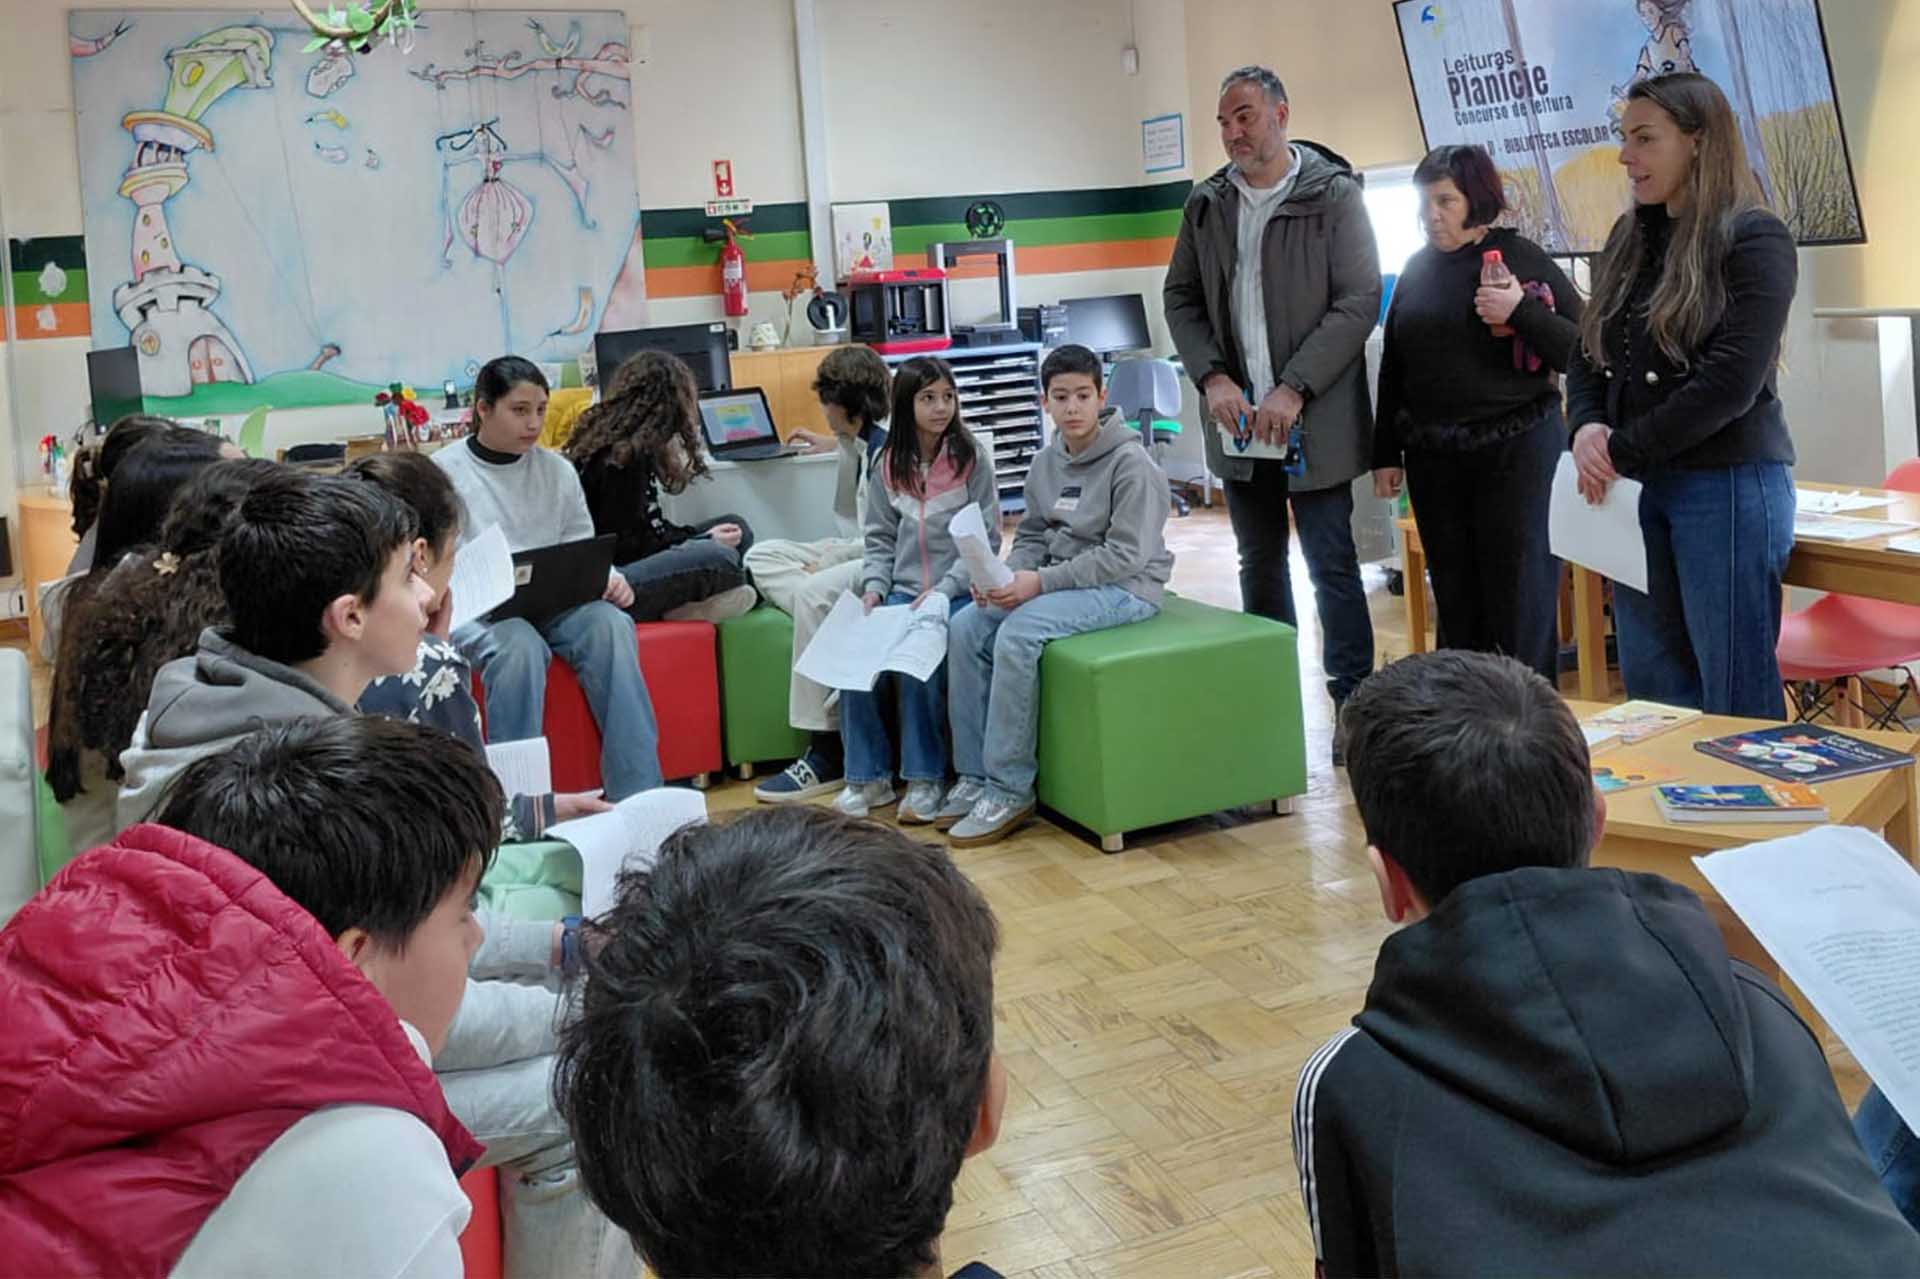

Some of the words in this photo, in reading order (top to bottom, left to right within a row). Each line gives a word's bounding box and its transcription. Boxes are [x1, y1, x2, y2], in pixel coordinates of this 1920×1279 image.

[1443, 50, 1515, 76] Leituras
[1447, 61, 1549, 109] Planície
[1513, 101, 1527, 117] de
[1531, 95, 1574, 115] leitura
[1504, 132, 1561, 154] BIBLIOTECA
[1562, 125, 1610, 147] ESCOLAR
